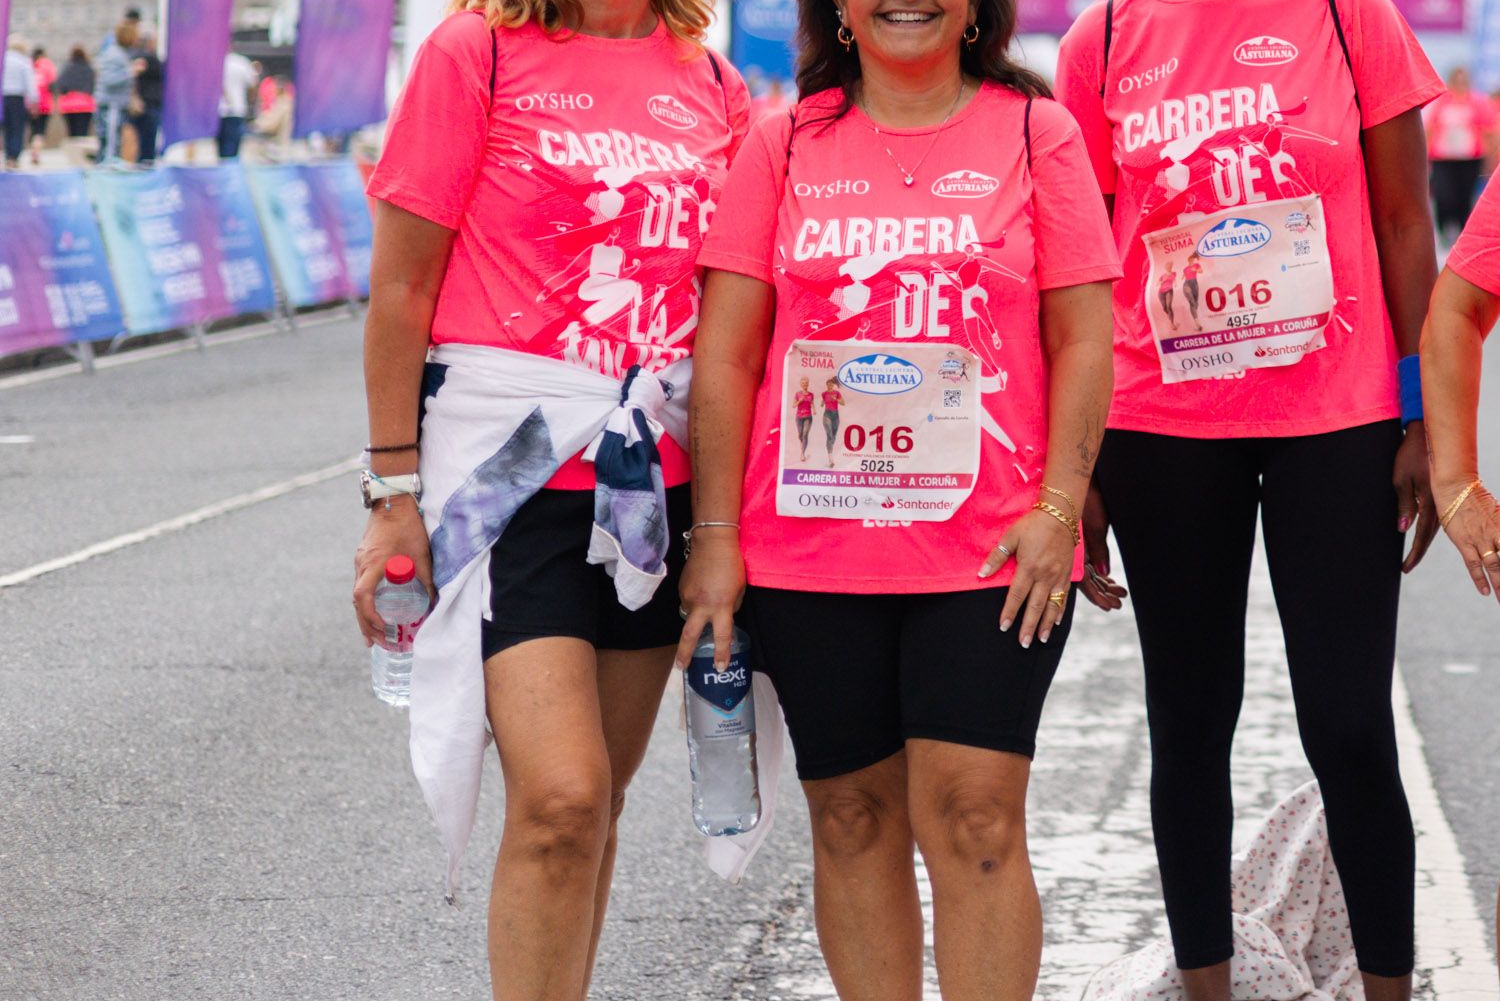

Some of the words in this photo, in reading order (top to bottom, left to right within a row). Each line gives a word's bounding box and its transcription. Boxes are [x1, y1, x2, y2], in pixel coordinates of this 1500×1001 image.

[1239, 48, 1293, 60] ASTURIANA
[1118, 57, 1179, 94] OYSHO
[515, 93, 593, 112] OYSHO
[651, 103, 694, 126] ASTURIANA
[1123, 83, 1283, 153] CARRERA
[537, 128, 708, 173] CARRERA
[1210, 142, 1269, 207] DE
[794, 180, 870, 198] OYSHO
[936, 181, 994, 193] ASTURIANA
[638, 182, 698, 249] DE
[793, 214, 983, 262] CARRERA
[1164, 238, 1193, 254] SUMA
[1202, 232, 1266, 253] ASTURIANA
[892, 270, 958, 338] DE
[1205, 279, 1272, 313] 016
[627, 283, 667, 344] LA
[1226, 313, 1258, 328] 4957
[1174, 337, 1210, 350] CARRERA
[1211, 334, 1223, 345] DE
[1225, 331, 1235, 342] LA
[1237, 328, 1266, 341] MUJER
[1274, 325, 1281, 333] A
[1282, 317, 1318, 332] CORUÑA
[801, 357, 835, 369] SUMA
[1181, 352, 1234, 371] OYSHO
[844, 368, 916, 385] ASTURIANA
[843, 424, 914, 453] 016
[860, 460, 894, 472] 5025
[797, 473, 837, 485] CARRERA
[839, 474, 851, 485] DE
[853, 475, 866, 486] LA
[868, 475, 900, 486] MUJER
[909, 477, 916, 486] A
[918, 474, 958, 487] CORUÑA
[798, 493, 858, 509] OYSHO
[897, 498, 953, 510] Santander
[704, 667, 746, 685] next
